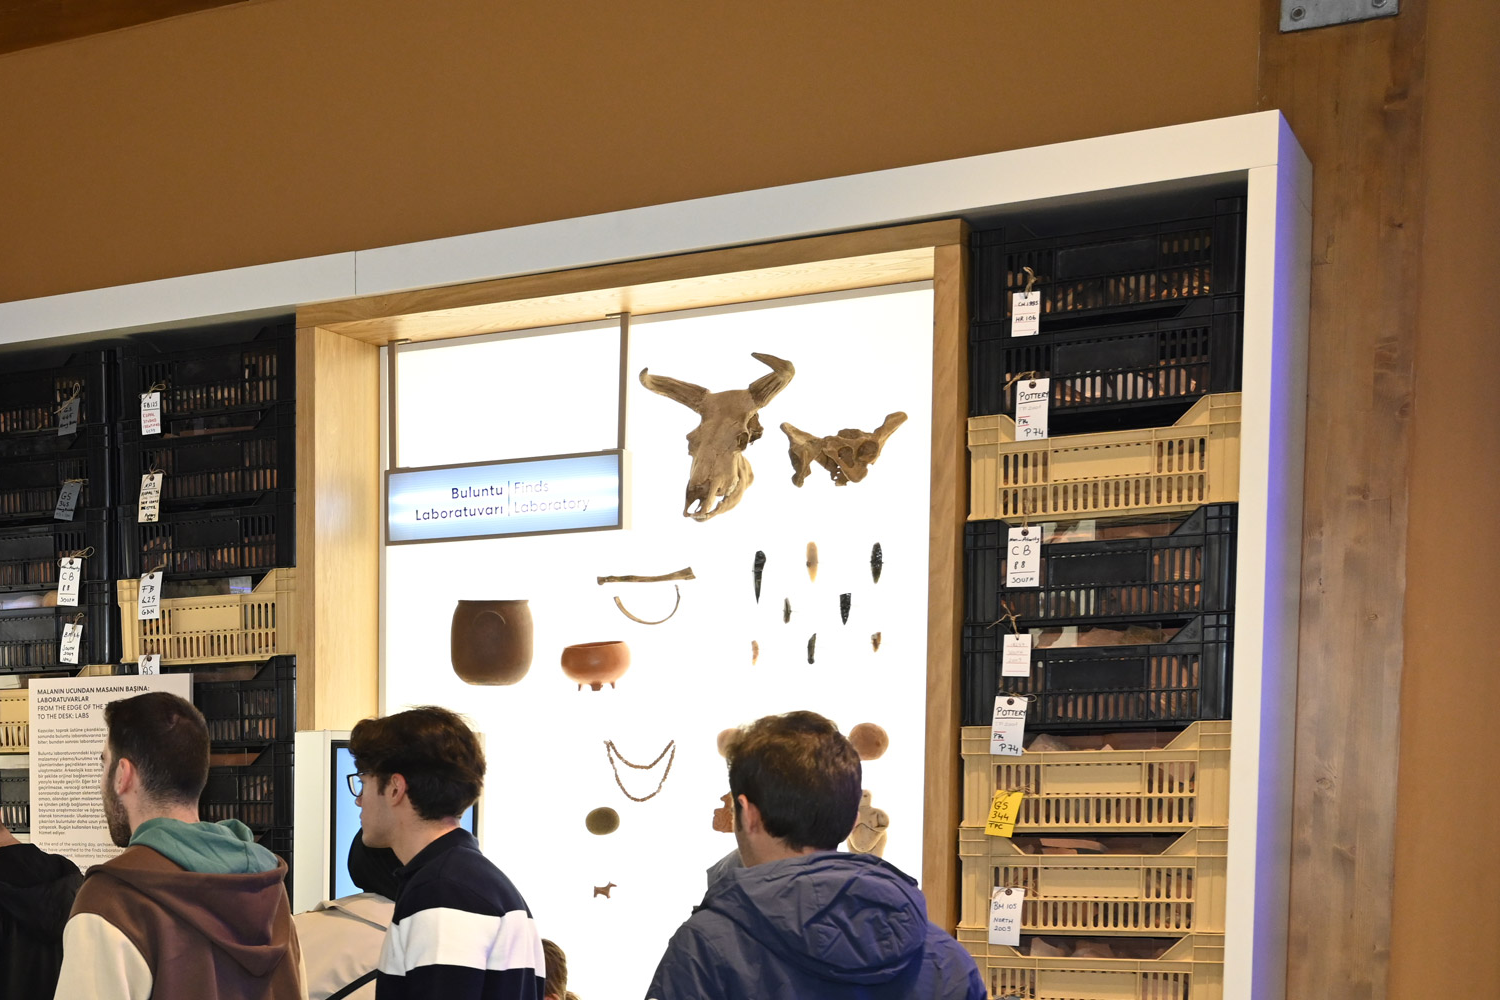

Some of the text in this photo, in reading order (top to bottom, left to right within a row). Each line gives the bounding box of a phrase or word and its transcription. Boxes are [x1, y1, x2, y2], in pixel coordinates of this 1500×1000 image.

[1020, 391, 1049, 401] POTTERY
[451, 485, 503, 499] Buluntu
[514, 480, 549, 494] Finds
[61, 491, 71, 500] GS
[514, 497, 590, 514] Laboratory
[415, 504, 503, 521] Laboratuvarı
[996, 707, 1026, 717] POTTERY
[994, 800, 1008, 811] GS
[991, 811, 1009, 821] 344
[993, 901, 1004, 910] BM
